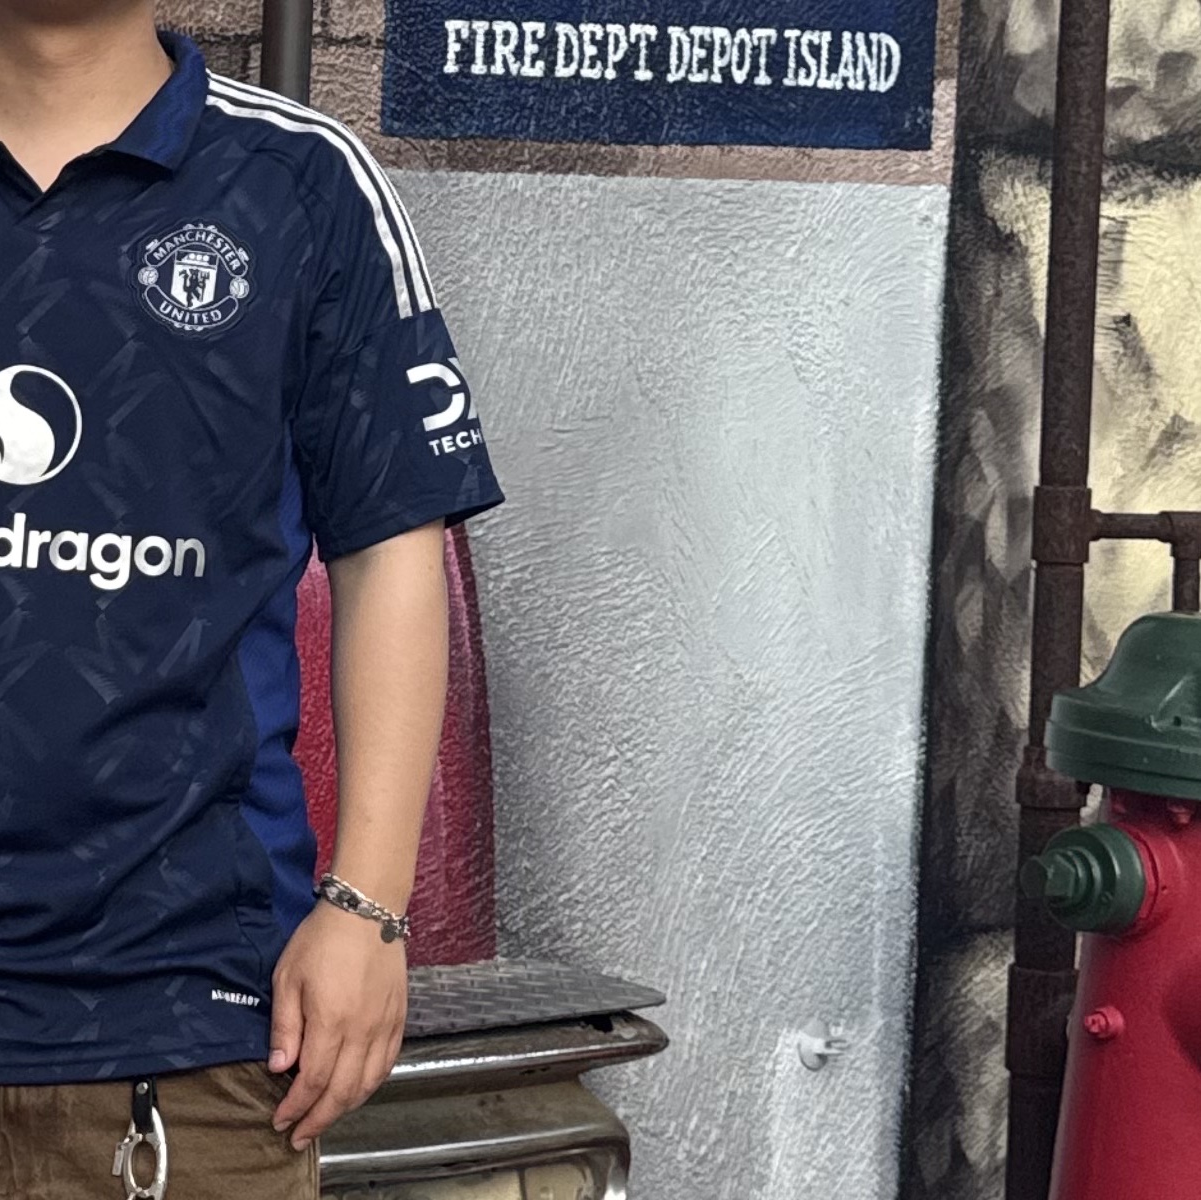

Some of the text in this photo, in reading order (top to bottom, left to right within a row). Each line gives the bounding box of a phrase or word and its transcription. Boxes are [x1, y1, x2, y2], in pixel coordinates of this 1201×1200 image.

[444, 20, 901, 93] FIRE DEPT DEPOT ISLAND
[152, 230, 241, 270] MANCHESTER
[159, 301, 222, 324] UNITED
